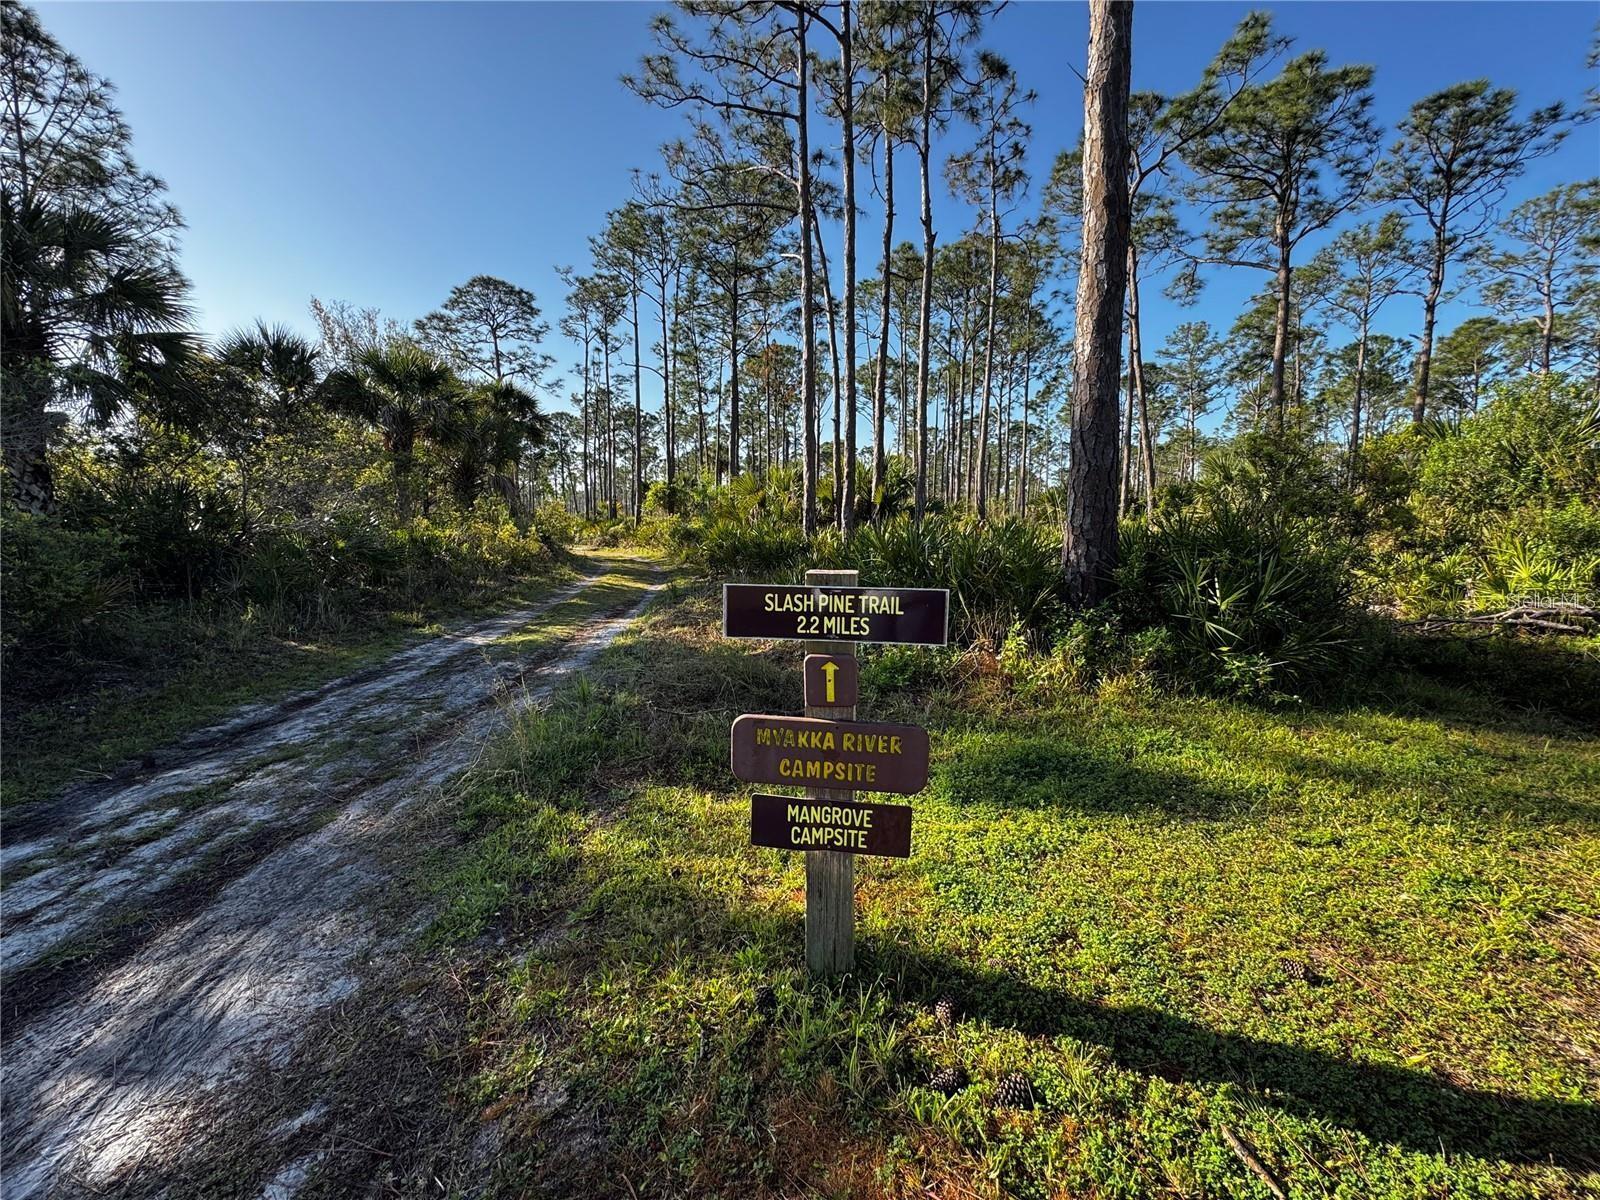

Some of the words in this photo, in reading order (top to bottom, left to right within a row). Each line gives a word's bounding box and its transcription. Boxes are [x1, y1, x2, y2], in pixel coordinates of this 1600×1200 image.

[764, 593, 813, 612] SLASH
[819, 595, 855, 614] PINE
[859, 595, 904, 615] TRAIL
[797, 616, 819, 634] 2.2
[824, 616, 870, 636] MILES
[756, 728, 835, 751] MYAKKA
[843, 733, 902, 754] RIVER
[779, 758, 876, 782] CAMPSITE
[787, 804, 873, 828] MANGROVE
[790, 826, 868, 849] CAMPSITE
